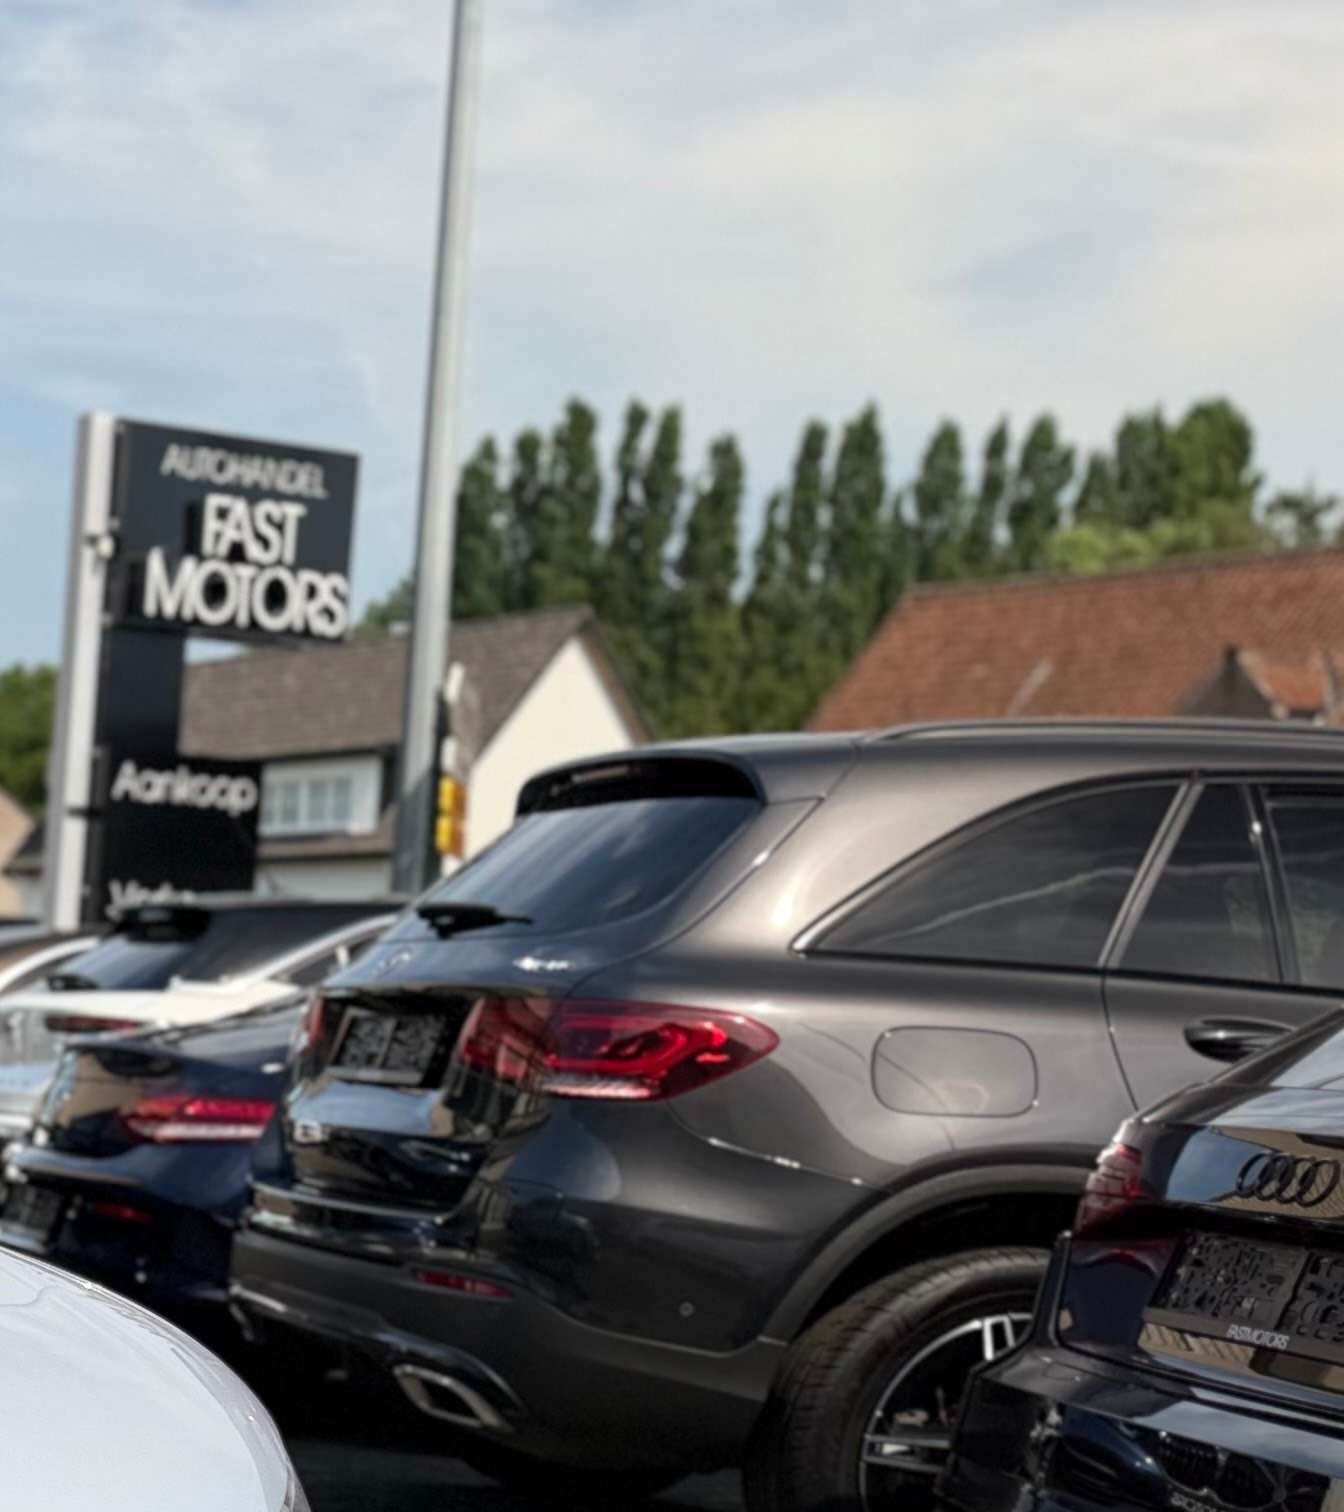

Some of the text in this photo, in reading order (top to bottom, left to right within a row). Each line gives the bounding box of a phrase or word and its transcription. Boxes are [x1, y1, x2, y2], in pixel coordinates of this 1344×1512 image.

[160, 443, 329, 500] AUTOHANDEL
[202, 493, 308, 564] FAST
[144, 548, 350, 639] MOTORS
[111, 760, 258, 818] Aankoop
